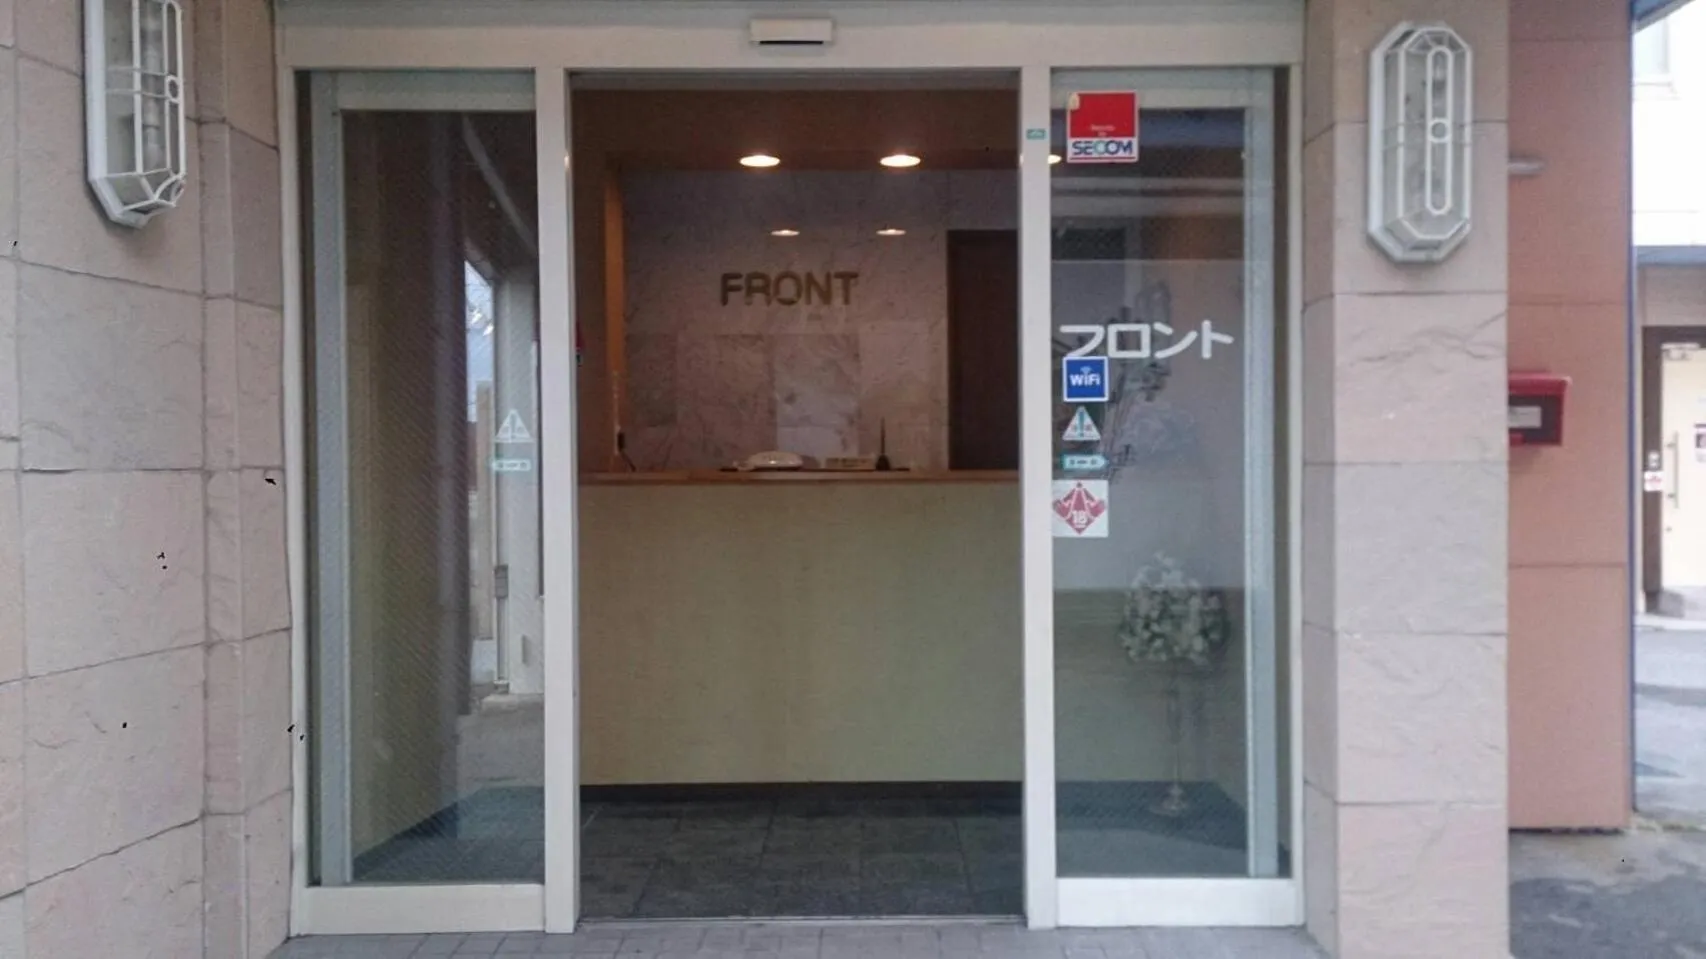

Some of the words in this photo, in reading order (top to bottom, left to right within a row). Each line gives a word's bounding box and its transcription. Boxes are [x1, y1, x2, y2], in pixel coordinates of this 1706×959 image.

[1072, 140, 1132, 156] SECOM
[720, 271, 859, 306] FRONT
[1060, 320, 1234, 359] フロント
[1070, 373, 1101, 387] WiFi
